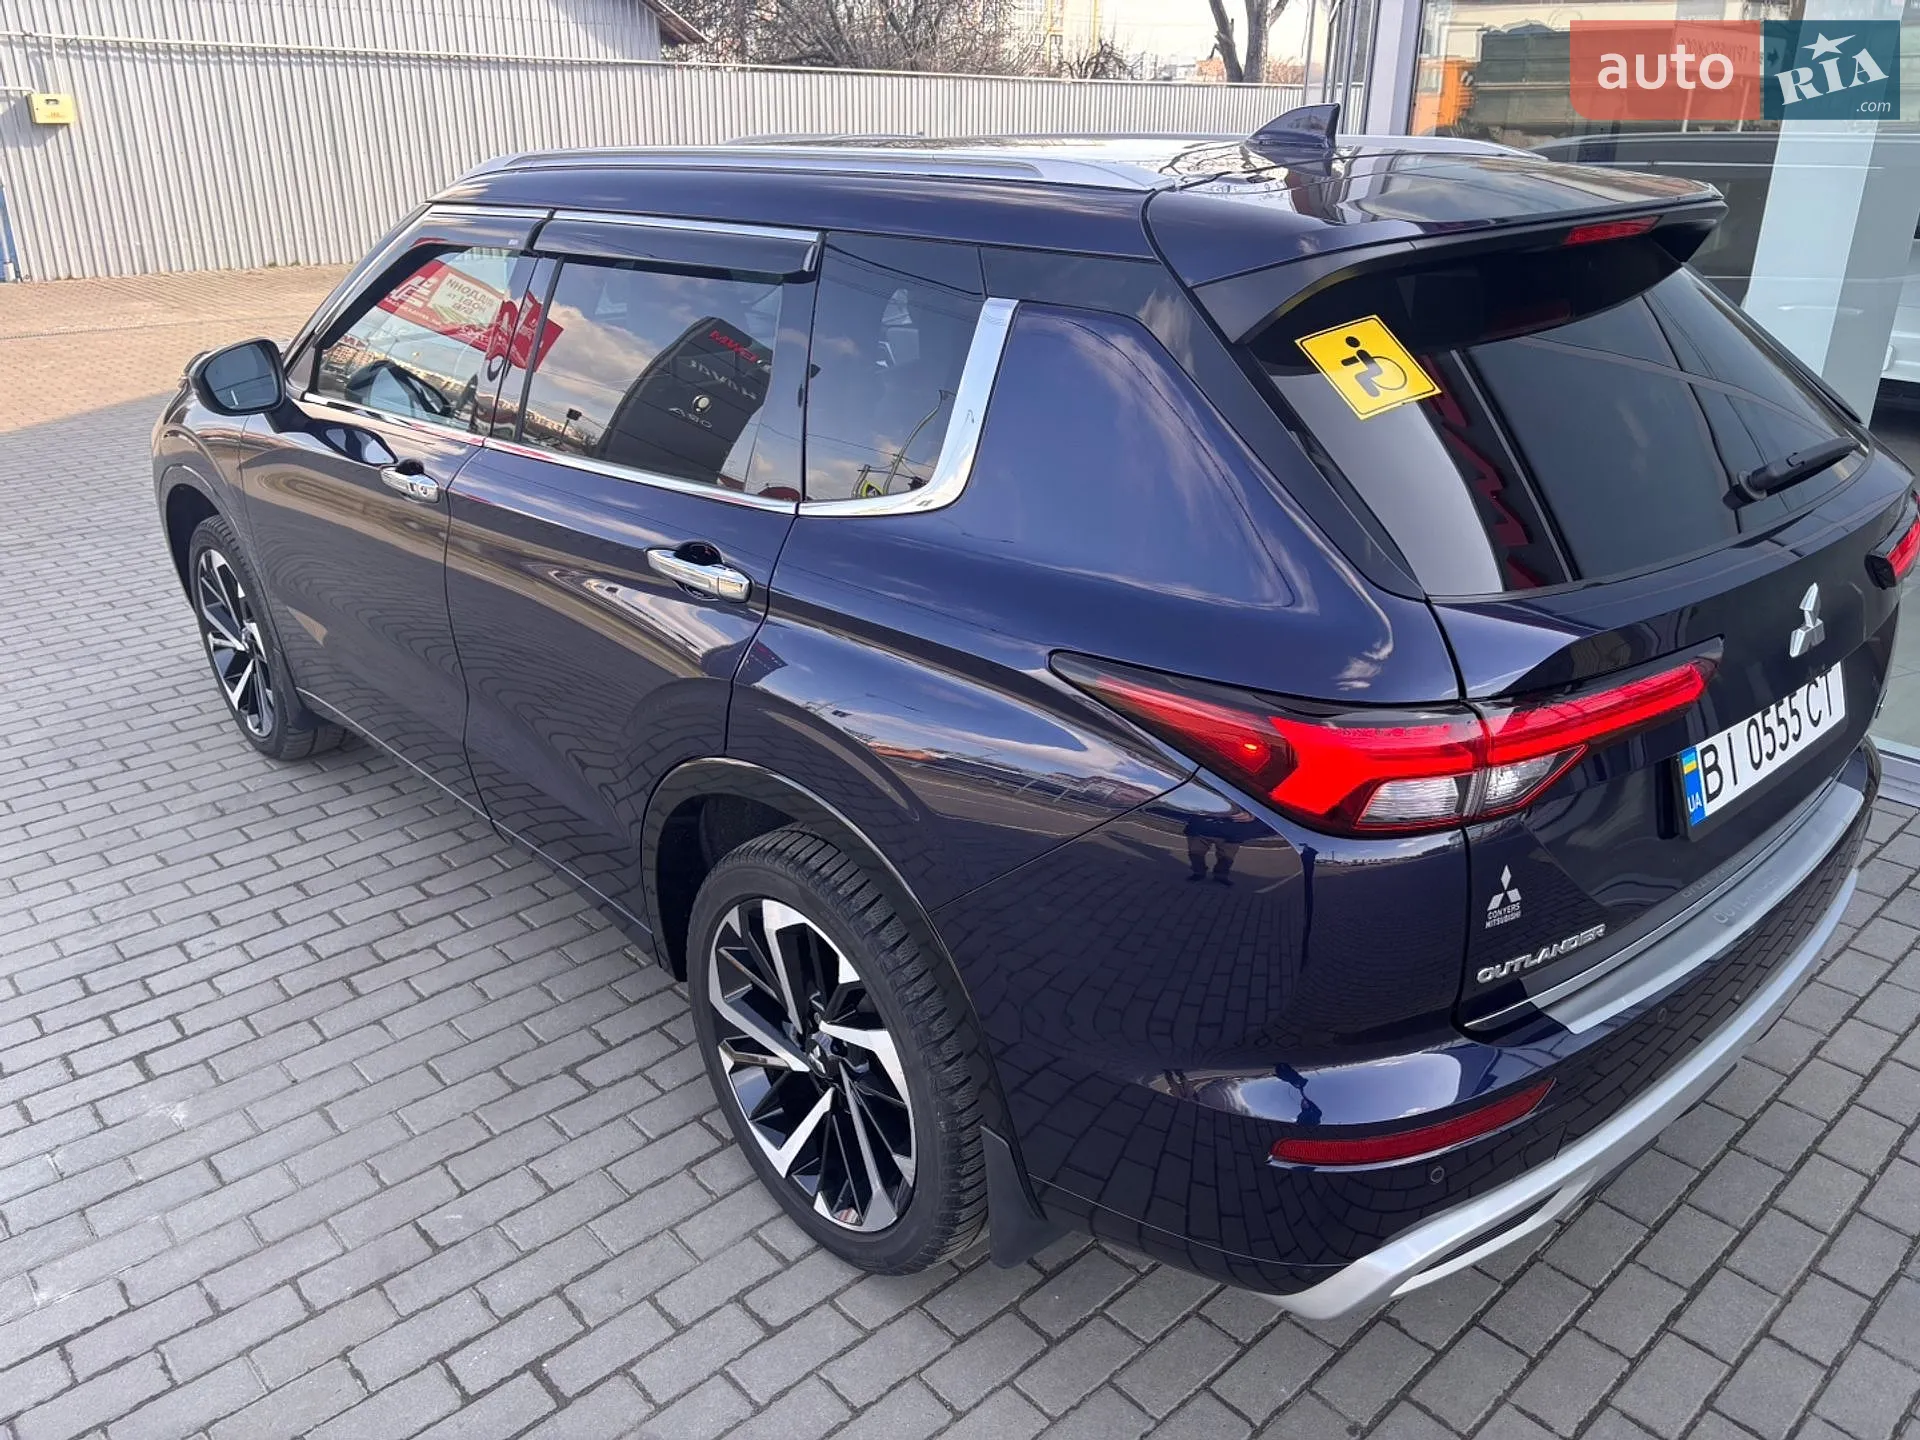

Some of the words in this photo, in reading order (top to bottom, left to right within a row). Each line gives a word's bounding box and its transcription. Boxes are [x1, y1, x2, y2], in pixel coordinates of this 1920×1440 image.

[1701, 733, 1738, 804] BI
[1747, 694, 1802, 771] 0555
[1806, 668, 1833, 728] CT
[1687, 792, 1702, 812] UA
[1485, 911, 1521, 929] MITSUBISHI
[1487, 902, 1520, 920] CONYERS
[1477, 923, 1606, 983] OUTLANDER
